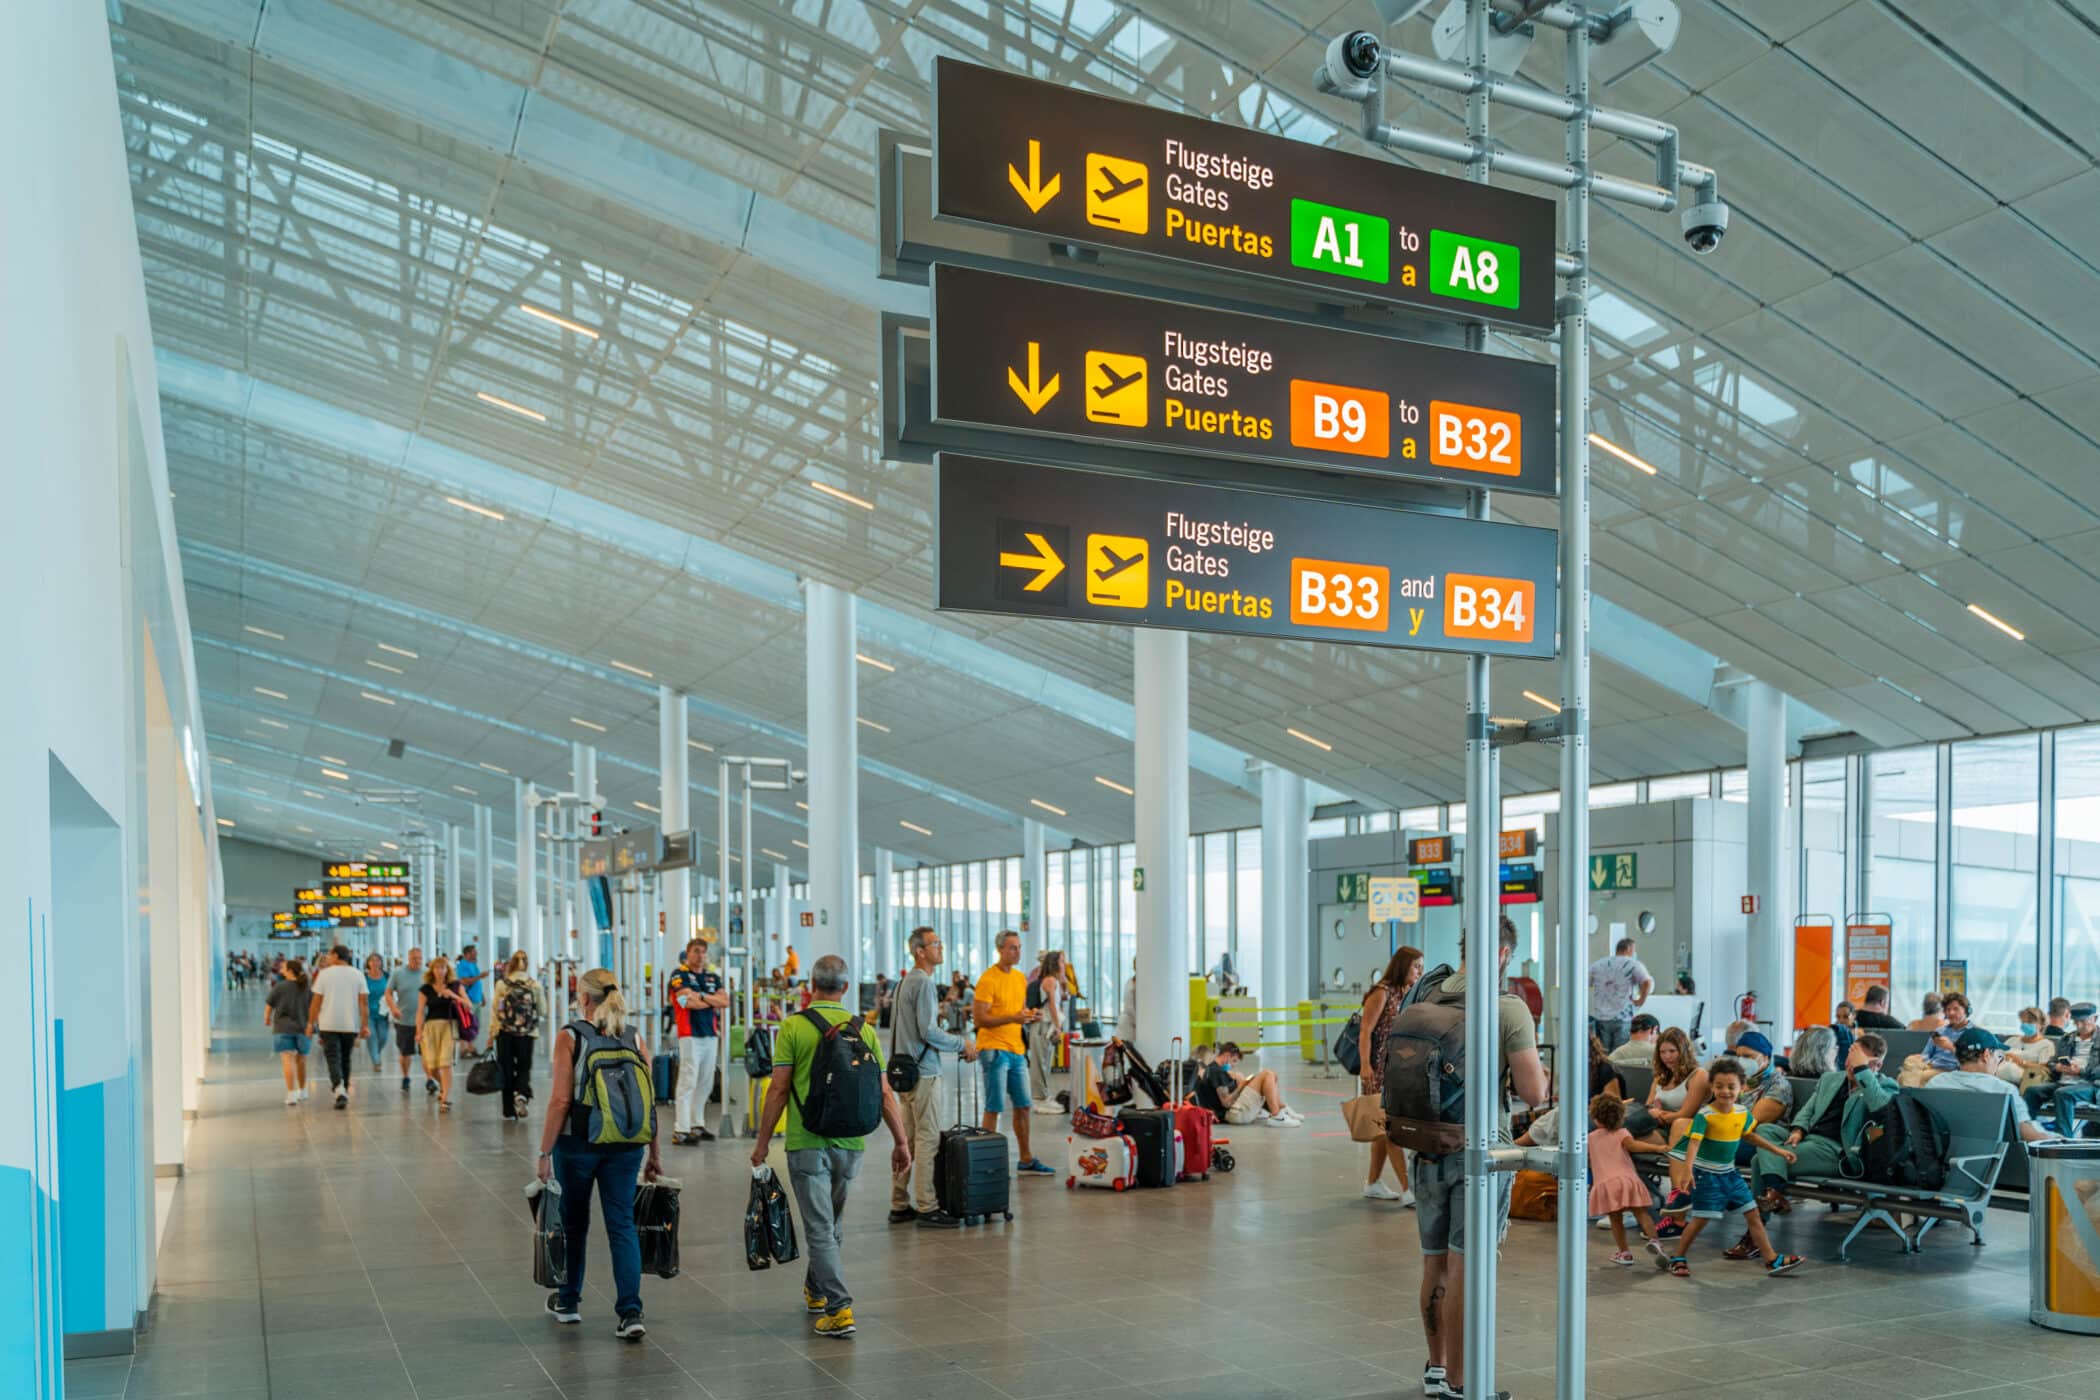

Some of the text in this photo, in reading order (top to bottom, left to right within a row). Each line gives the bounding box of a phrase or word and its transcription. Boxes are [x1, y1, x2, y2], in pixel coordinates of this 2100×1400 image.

[1165, 138, 1274, 190] Flugsteige
[1166, 173, 1229, 211] Gates
[1166, 207, 1273, 258] Puertas
[1312, 215, 1499, 295] A1 to A8
[1402, 264, 1417, 287] a
[1165, 330, 1273, 374] Flugsteige
[1165, 364, 1228, 398] Gates
[1165, 398, 1273, 440] Puertas
[1313, 394, 1512, 464] B9 to B32
[1402, 437, 1417, 459] a
[1166, 511, 1274, 553] Flugsteige
[1166, 545, 1229, 577] Gates
[1165, 579, 1273, 619] Puertas
[1301, 570, 1526, 631] B33 and B34
[1409, 607, 1425, 636] y
[1418, 841, 1441, 859] B33
[1499, 835, 1522, 853] B34
